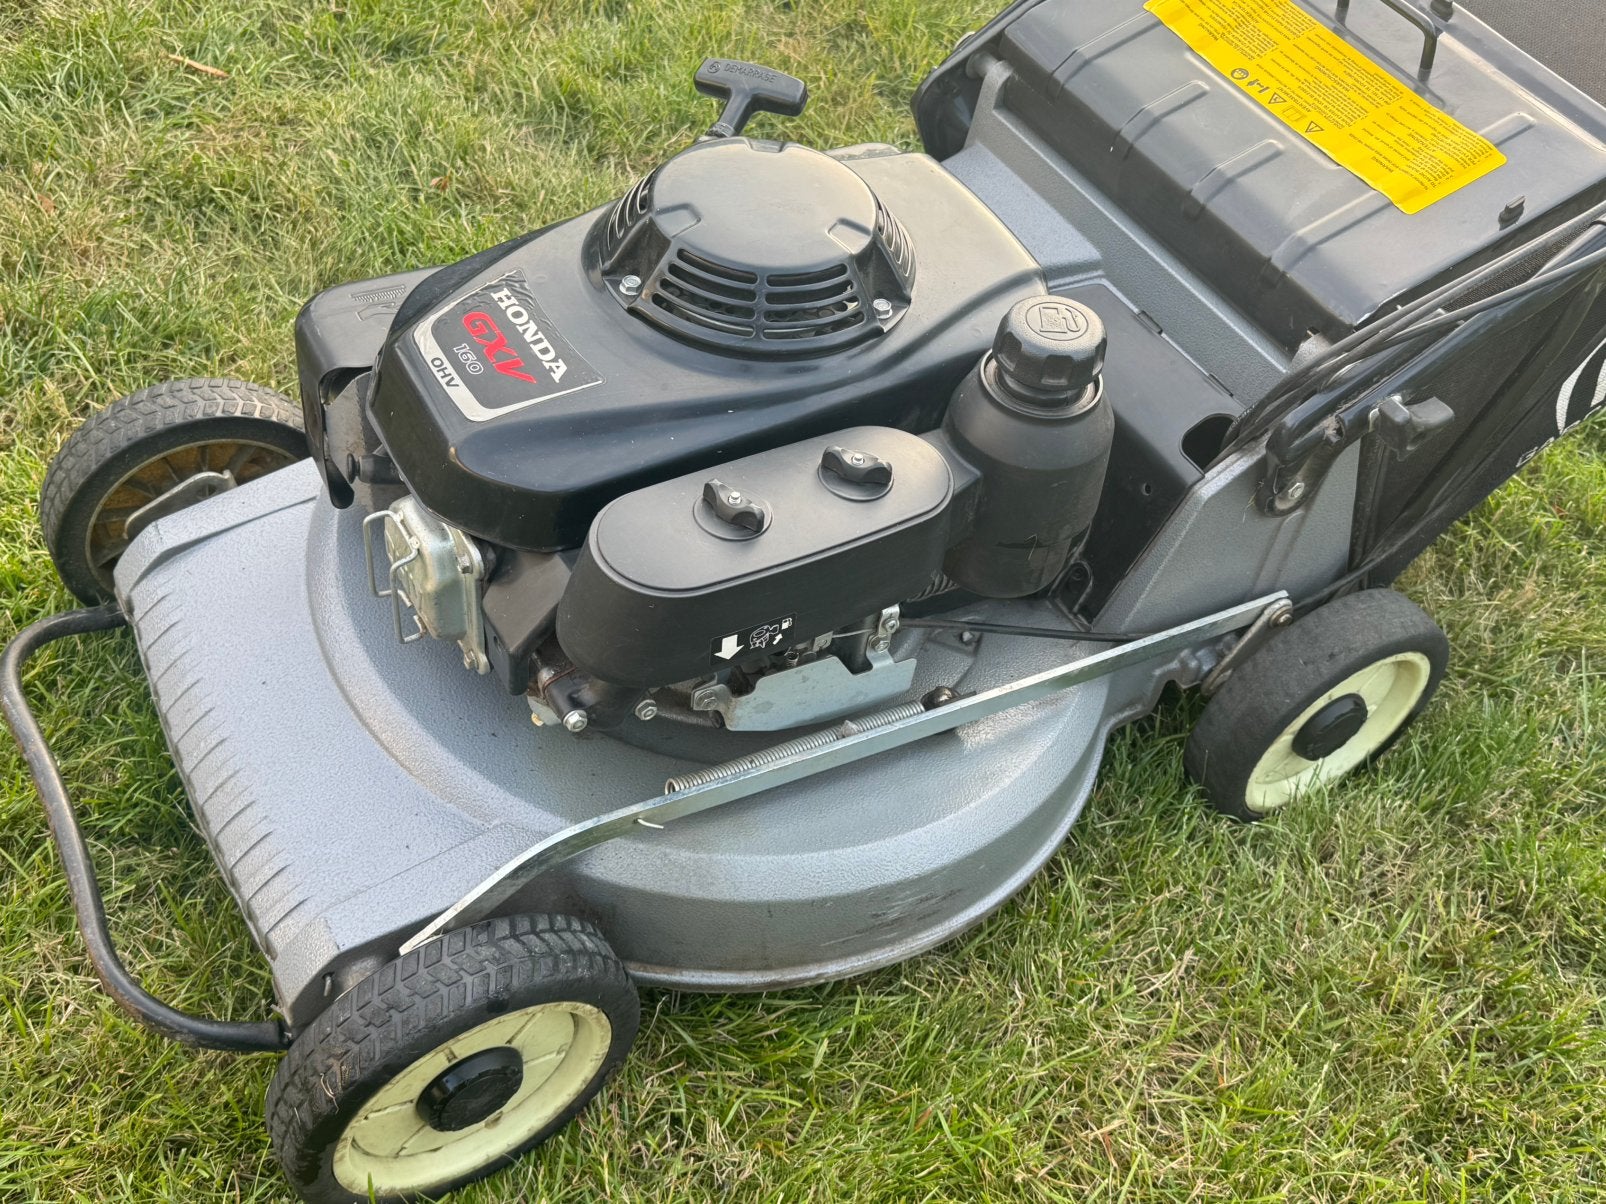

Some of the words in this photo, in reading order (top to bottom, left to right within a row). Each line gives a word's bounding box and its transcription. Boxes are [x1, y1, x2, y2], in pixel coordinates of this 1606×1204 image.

[453, 343, 484, 375] 160
[462, 311, 537, 384] GXV
[490, 288, 567, 383] HONDA
[430, 357, 459, 388] OHV
